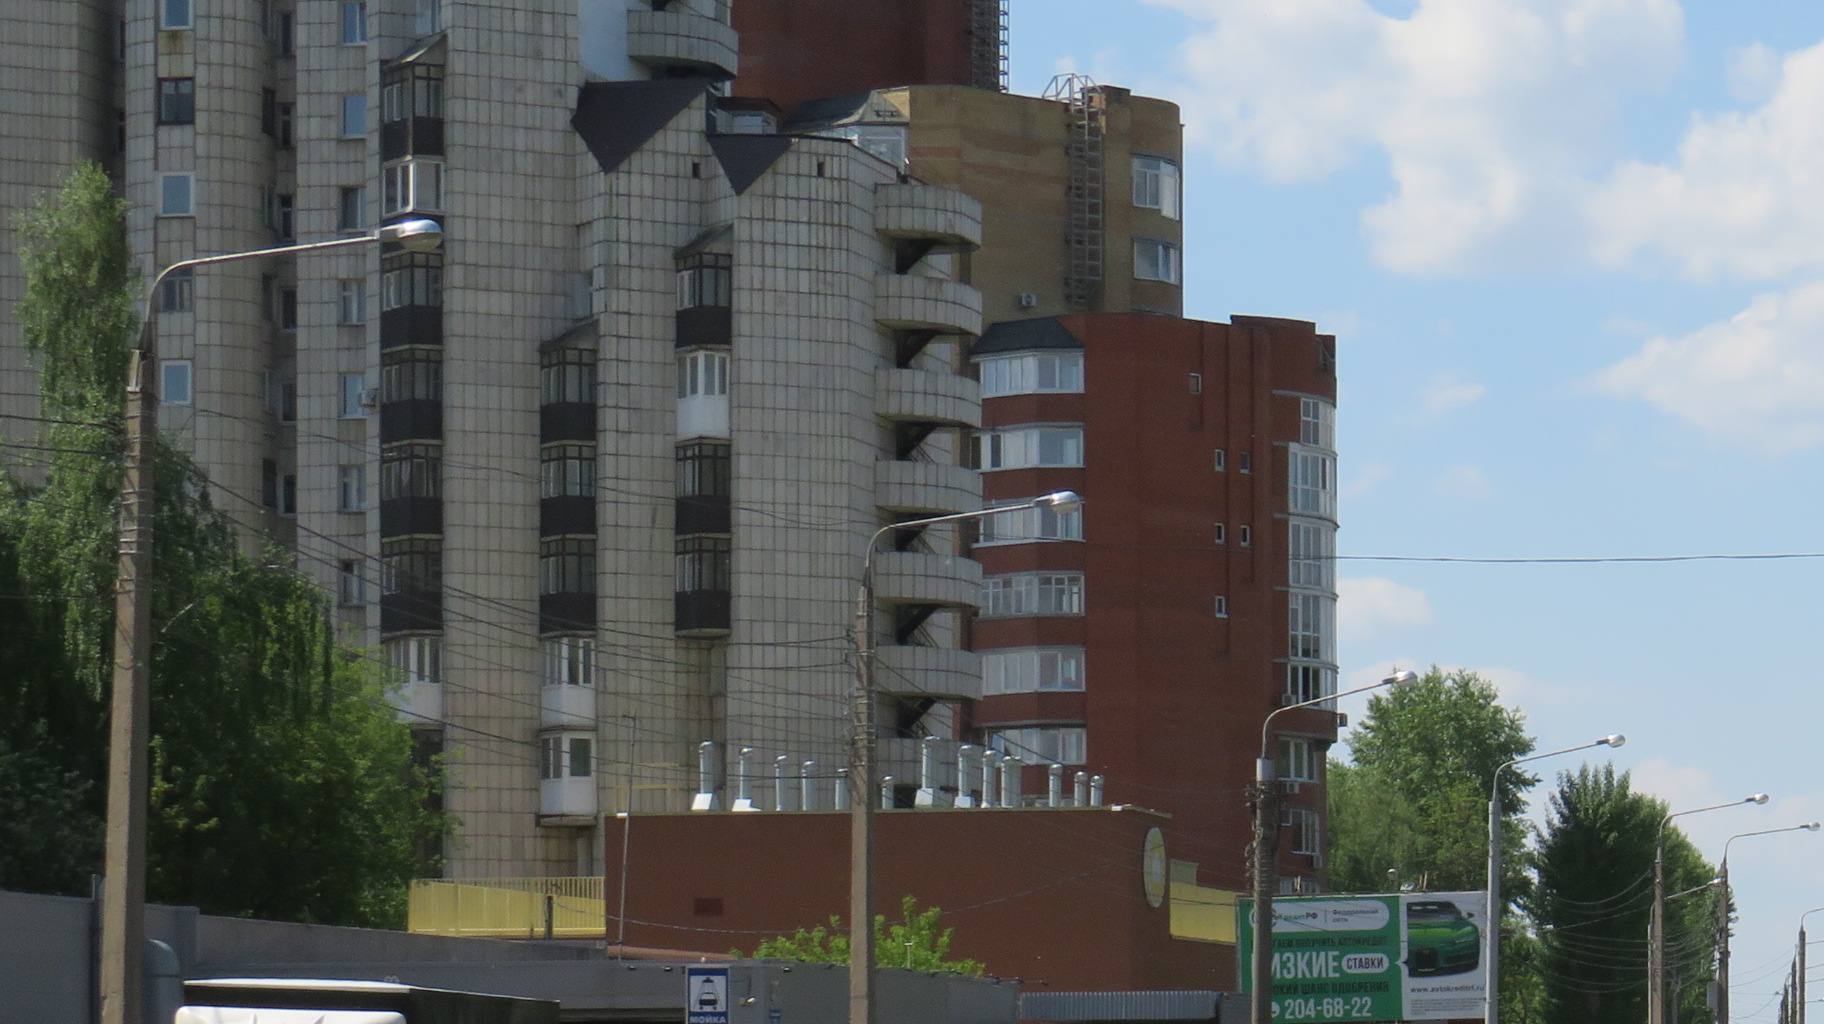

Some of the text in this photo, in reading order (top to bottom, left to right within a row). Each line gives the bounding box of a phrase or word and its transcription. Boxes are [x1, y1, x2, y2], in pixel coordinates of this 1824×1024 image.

[1270, 950, 1384, 979] ИЗКИЕ СТАВКИ
[690, 1014, 727, 1024] МОЙКА
[1284, 996, 1372, 1019] 204-68-22
